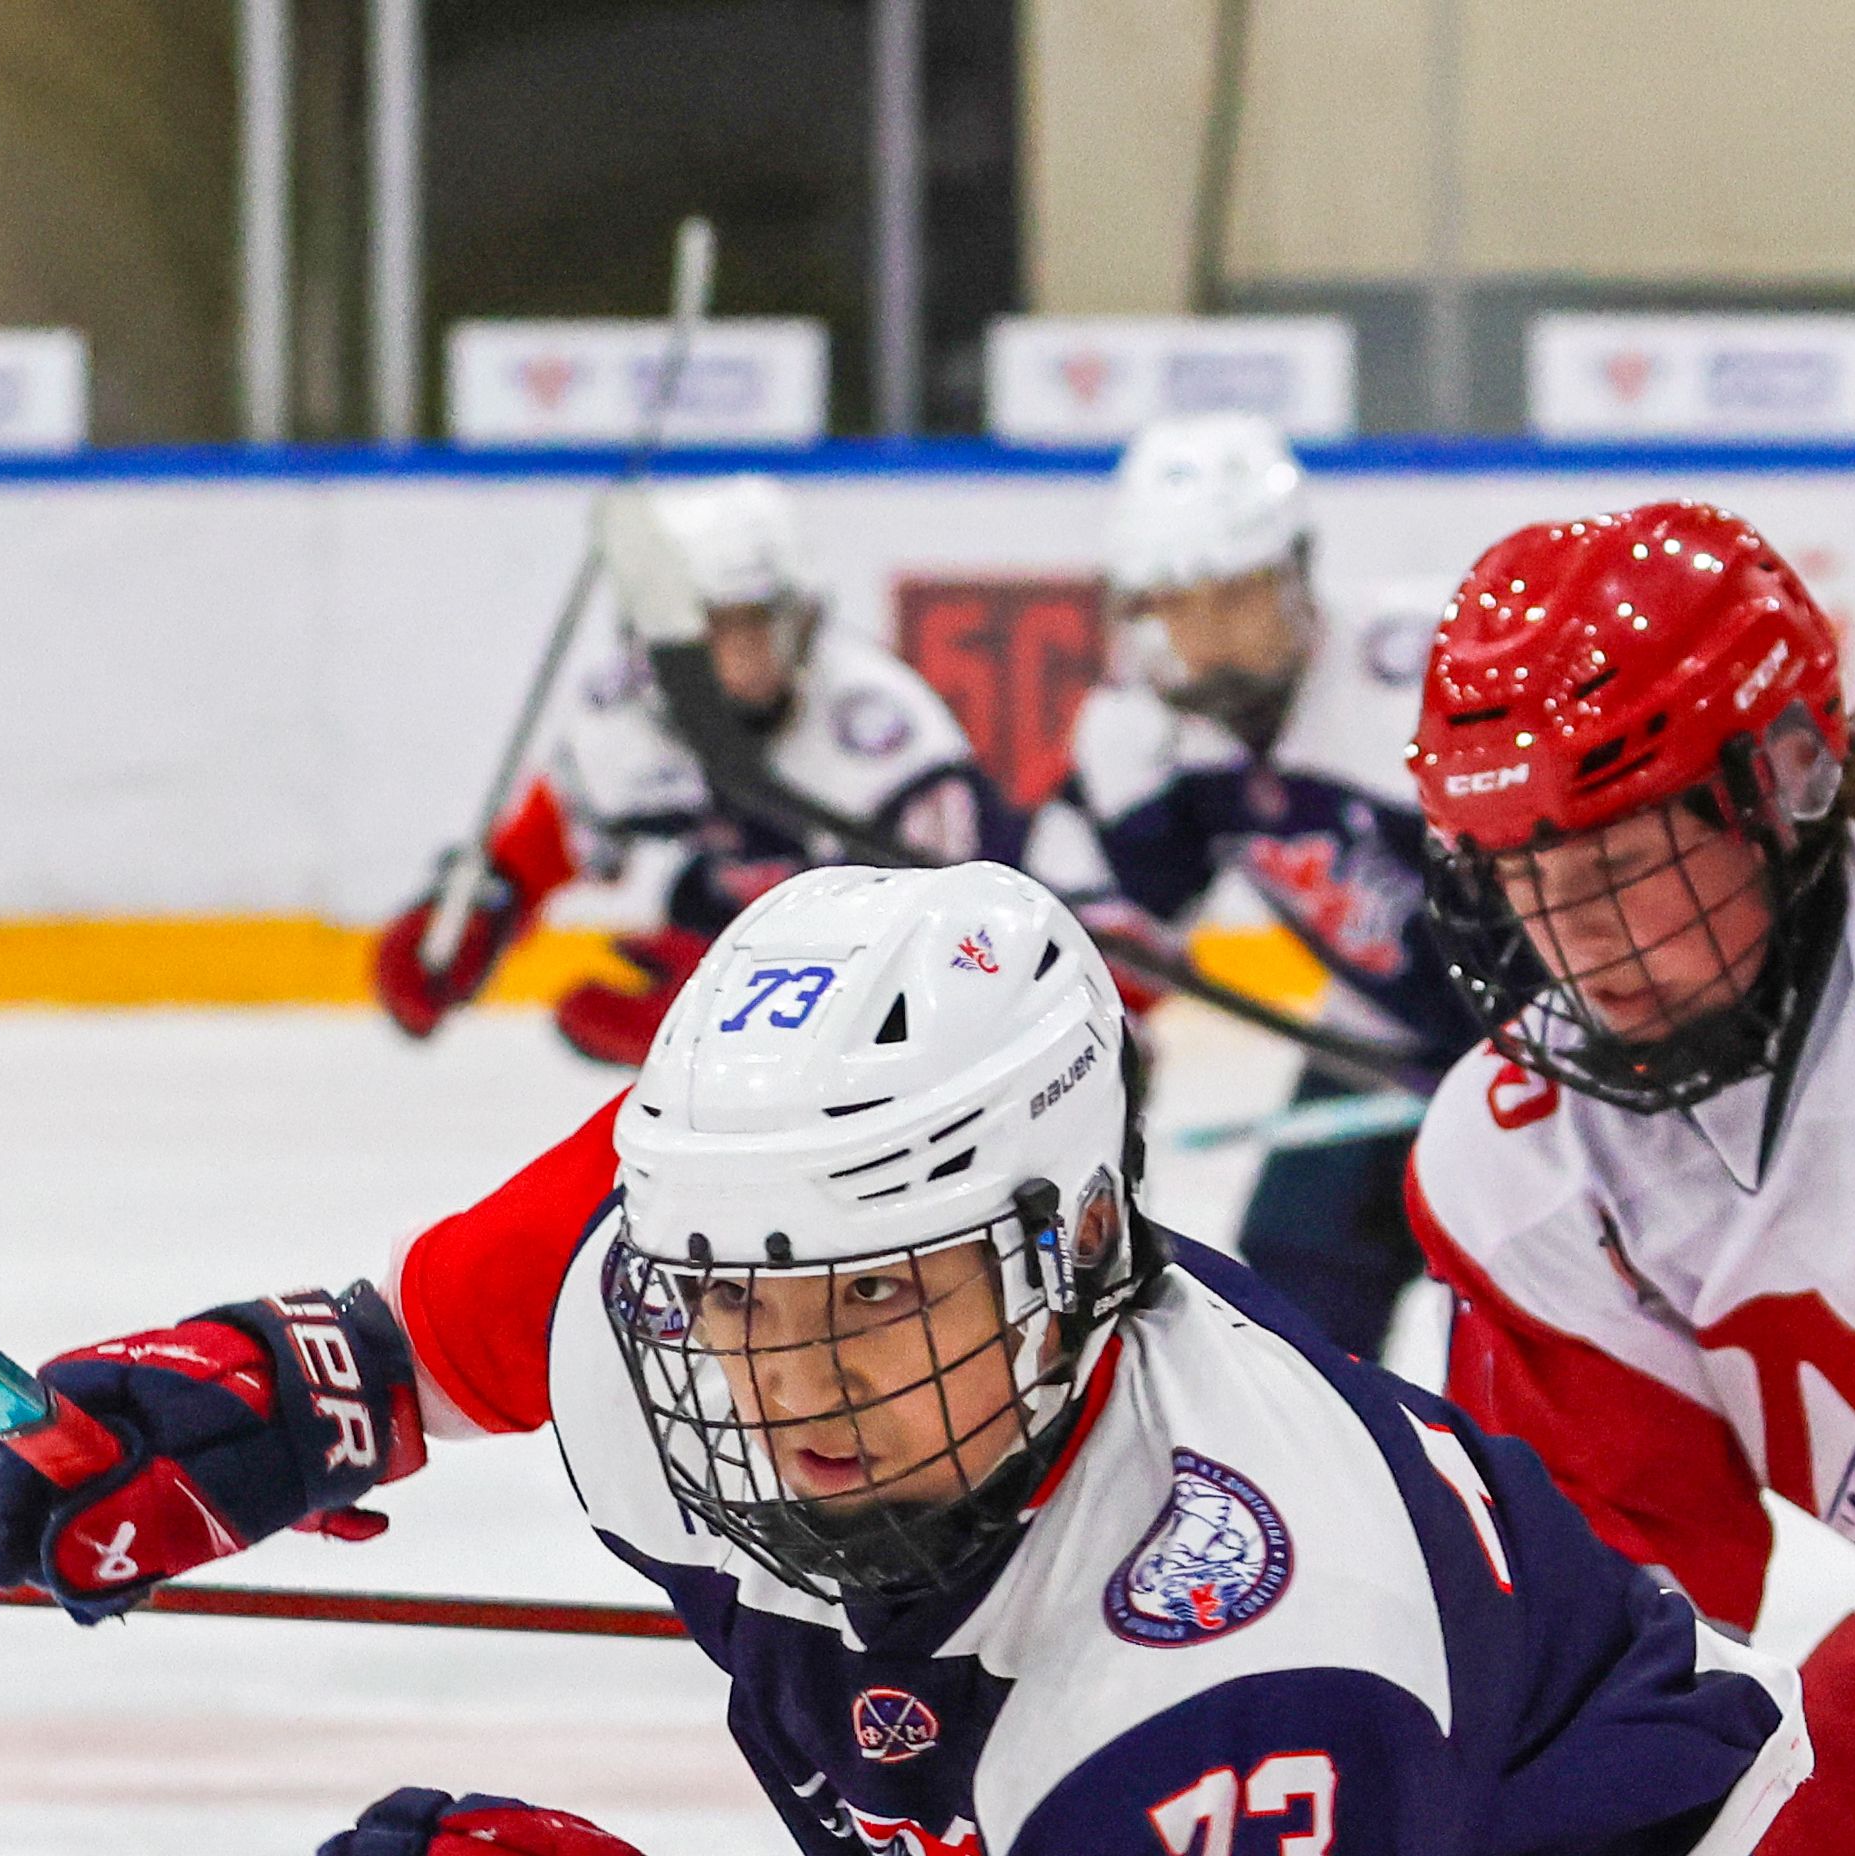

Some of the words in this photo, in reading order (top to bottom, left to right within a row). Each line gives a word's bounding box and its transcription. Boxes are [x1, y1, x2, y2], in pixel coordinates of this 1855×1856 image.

[1446, 763, 1530, 797] CCM
[720, 966, 835, 1032] 73
[1030, 1045, 1097, 1120] BAUER
[267, 1288, 377, 1471] UER
